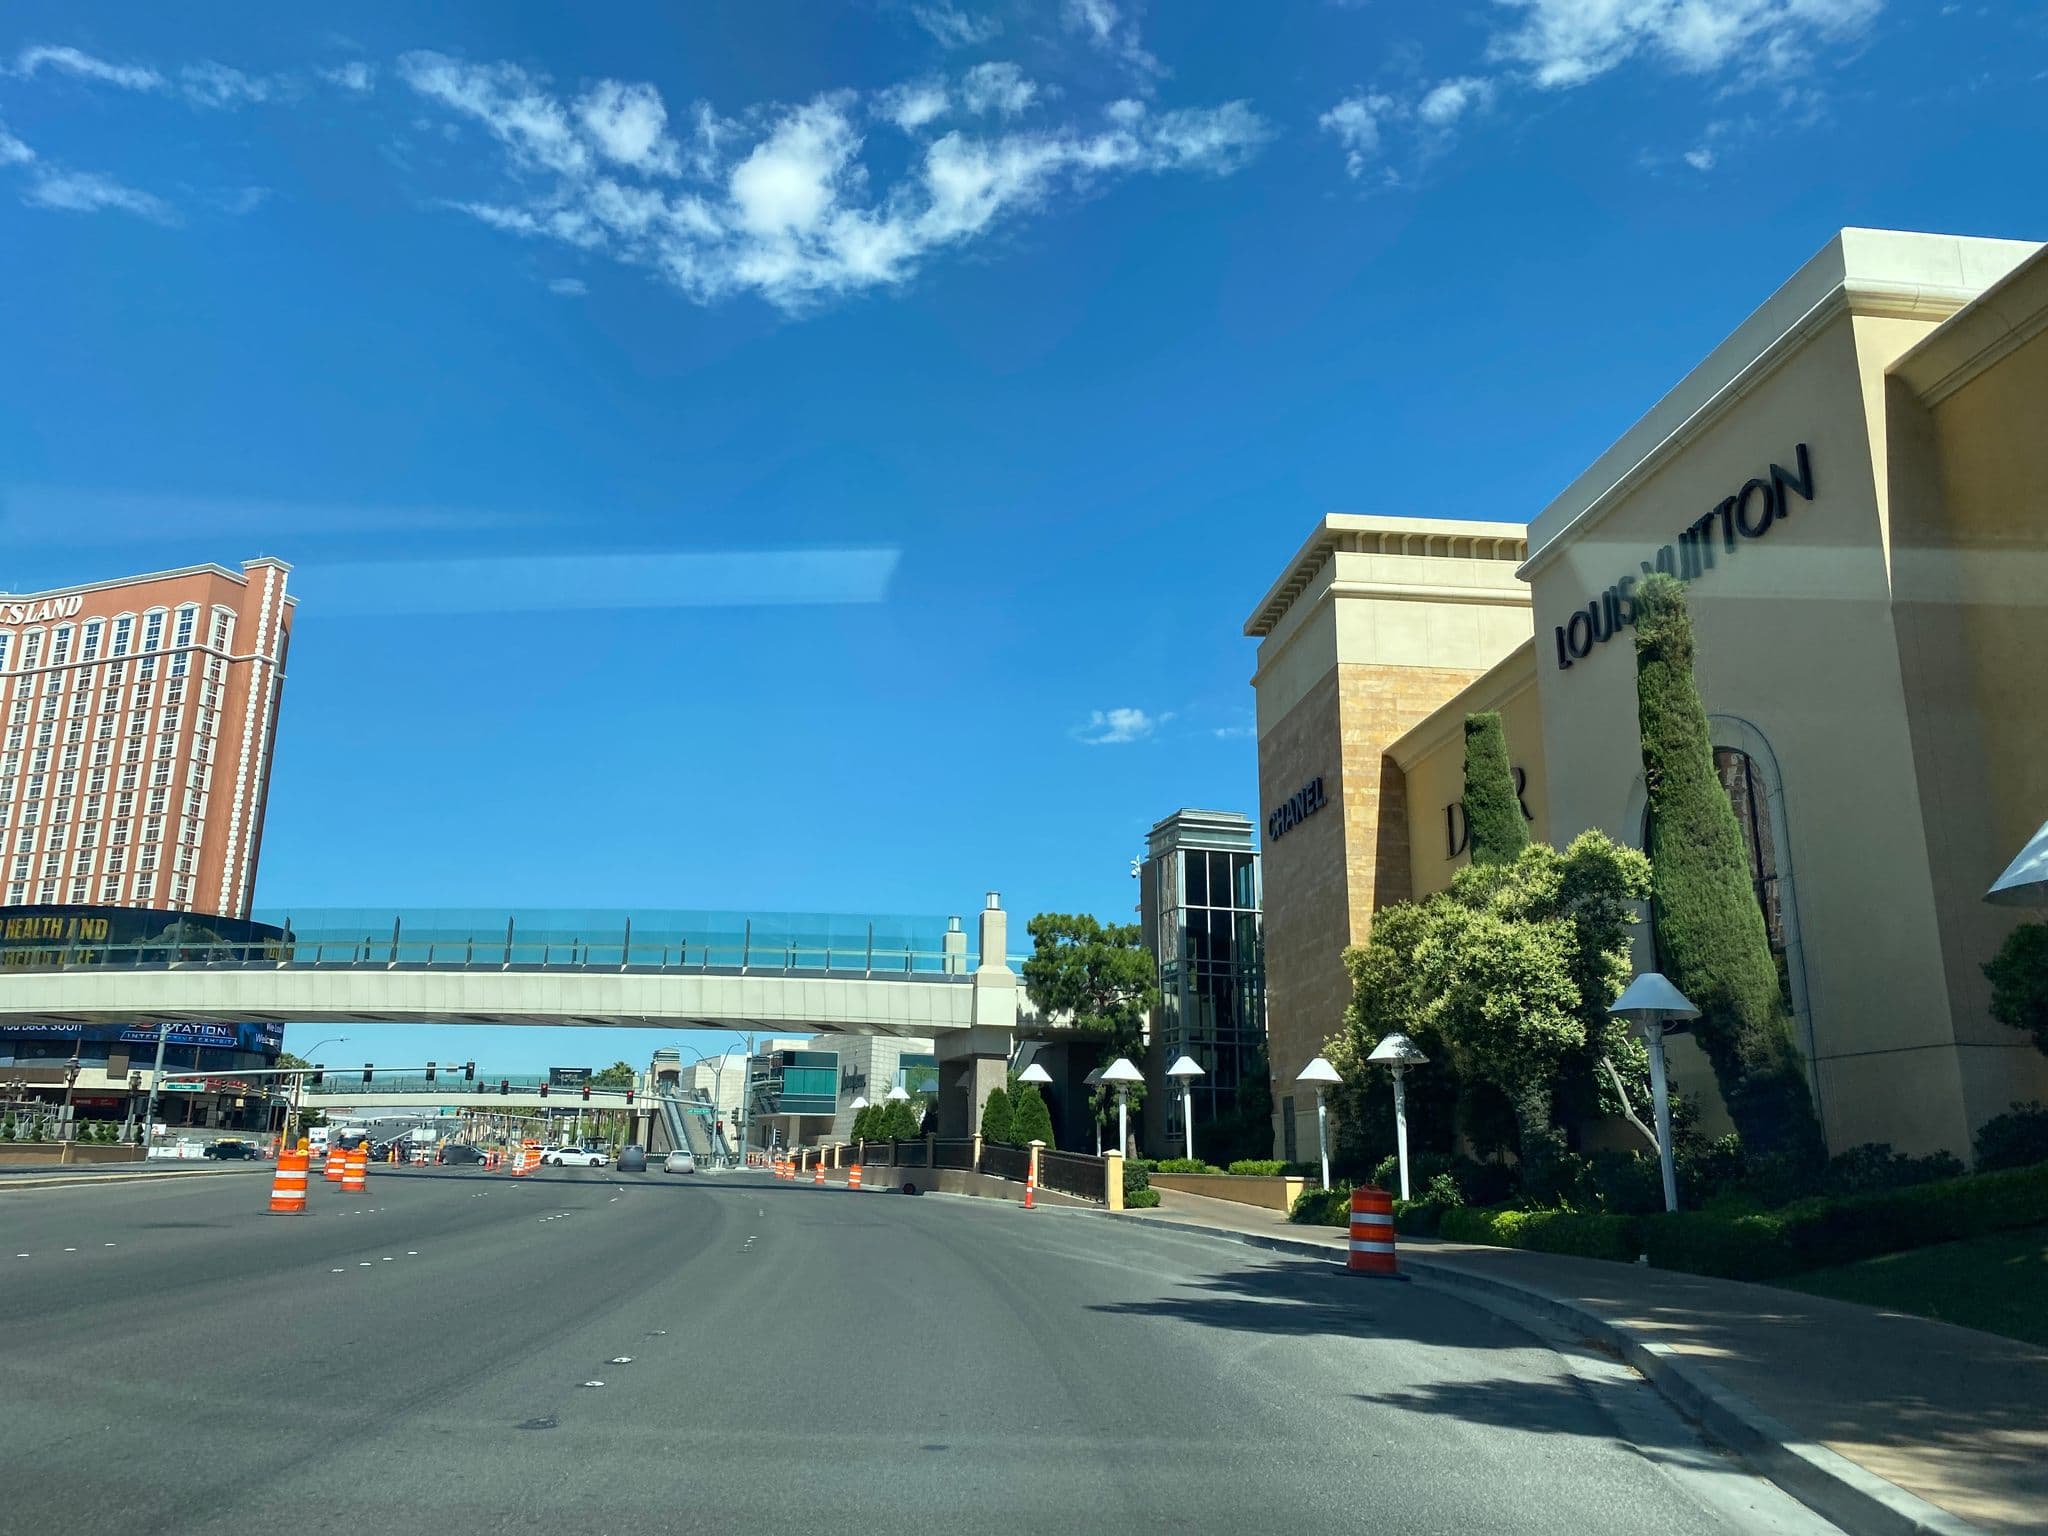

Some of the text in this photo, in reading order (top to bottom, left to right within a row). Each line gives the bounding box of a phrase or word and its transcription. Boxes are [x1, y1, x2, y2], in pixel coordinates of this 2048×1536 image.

[1555, 576, 1638, 670] LOUIS
[1268, 777, 1328, 842] CHANEL
[4, 917, 63, 940] HEALTH
